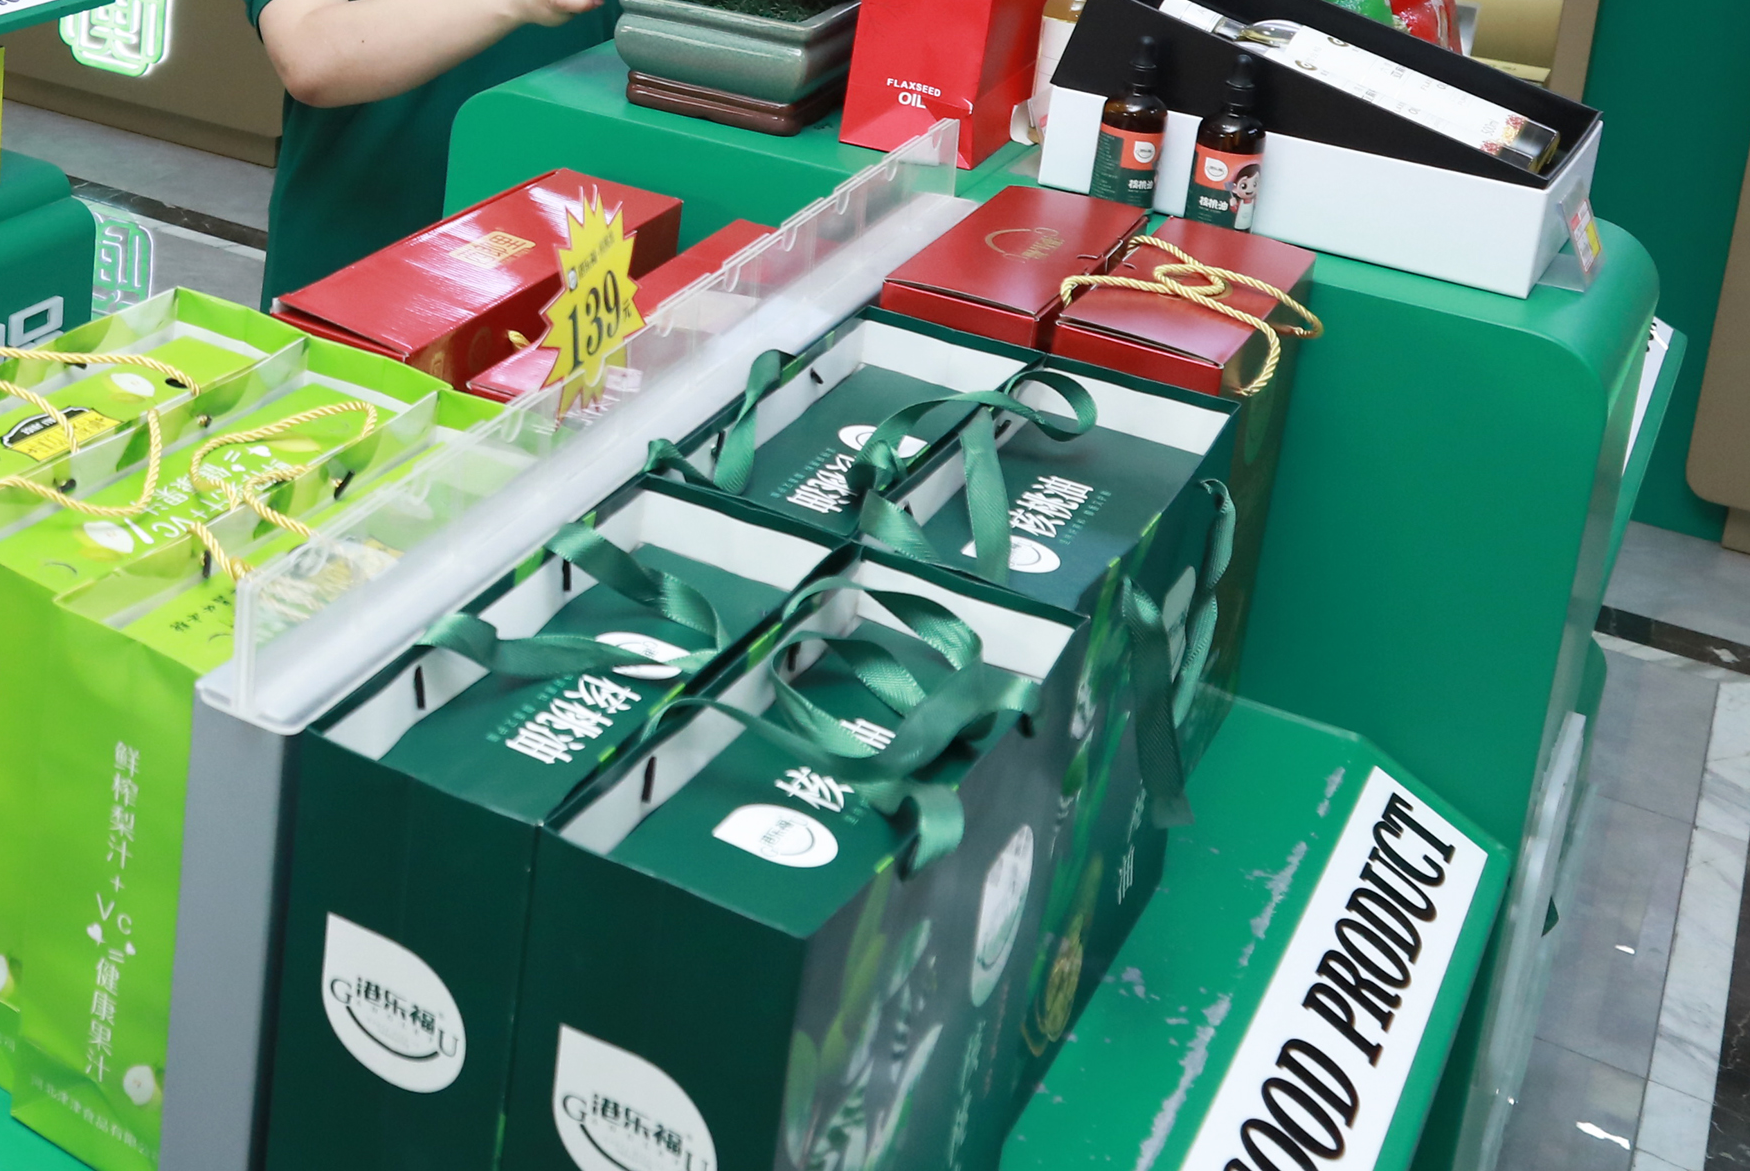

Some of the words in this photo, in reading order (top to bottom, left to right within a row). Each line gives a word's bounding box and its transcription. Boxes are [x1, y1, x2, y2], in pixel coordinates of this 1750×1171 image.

[887, 78, 941, 98] FLAXSEED
[898, 91, 927, 109] OIL
[568, 270, 621, 376] 139
[622, 299, 633, 322] 元
[356, 975, 437, 1034] 港乐福
[1220, 1036, 1362, 1171] OOD
[1301, 791, 1457, 1068] PRODUCT
[591, 1092, 684, 1157] 港乐福
